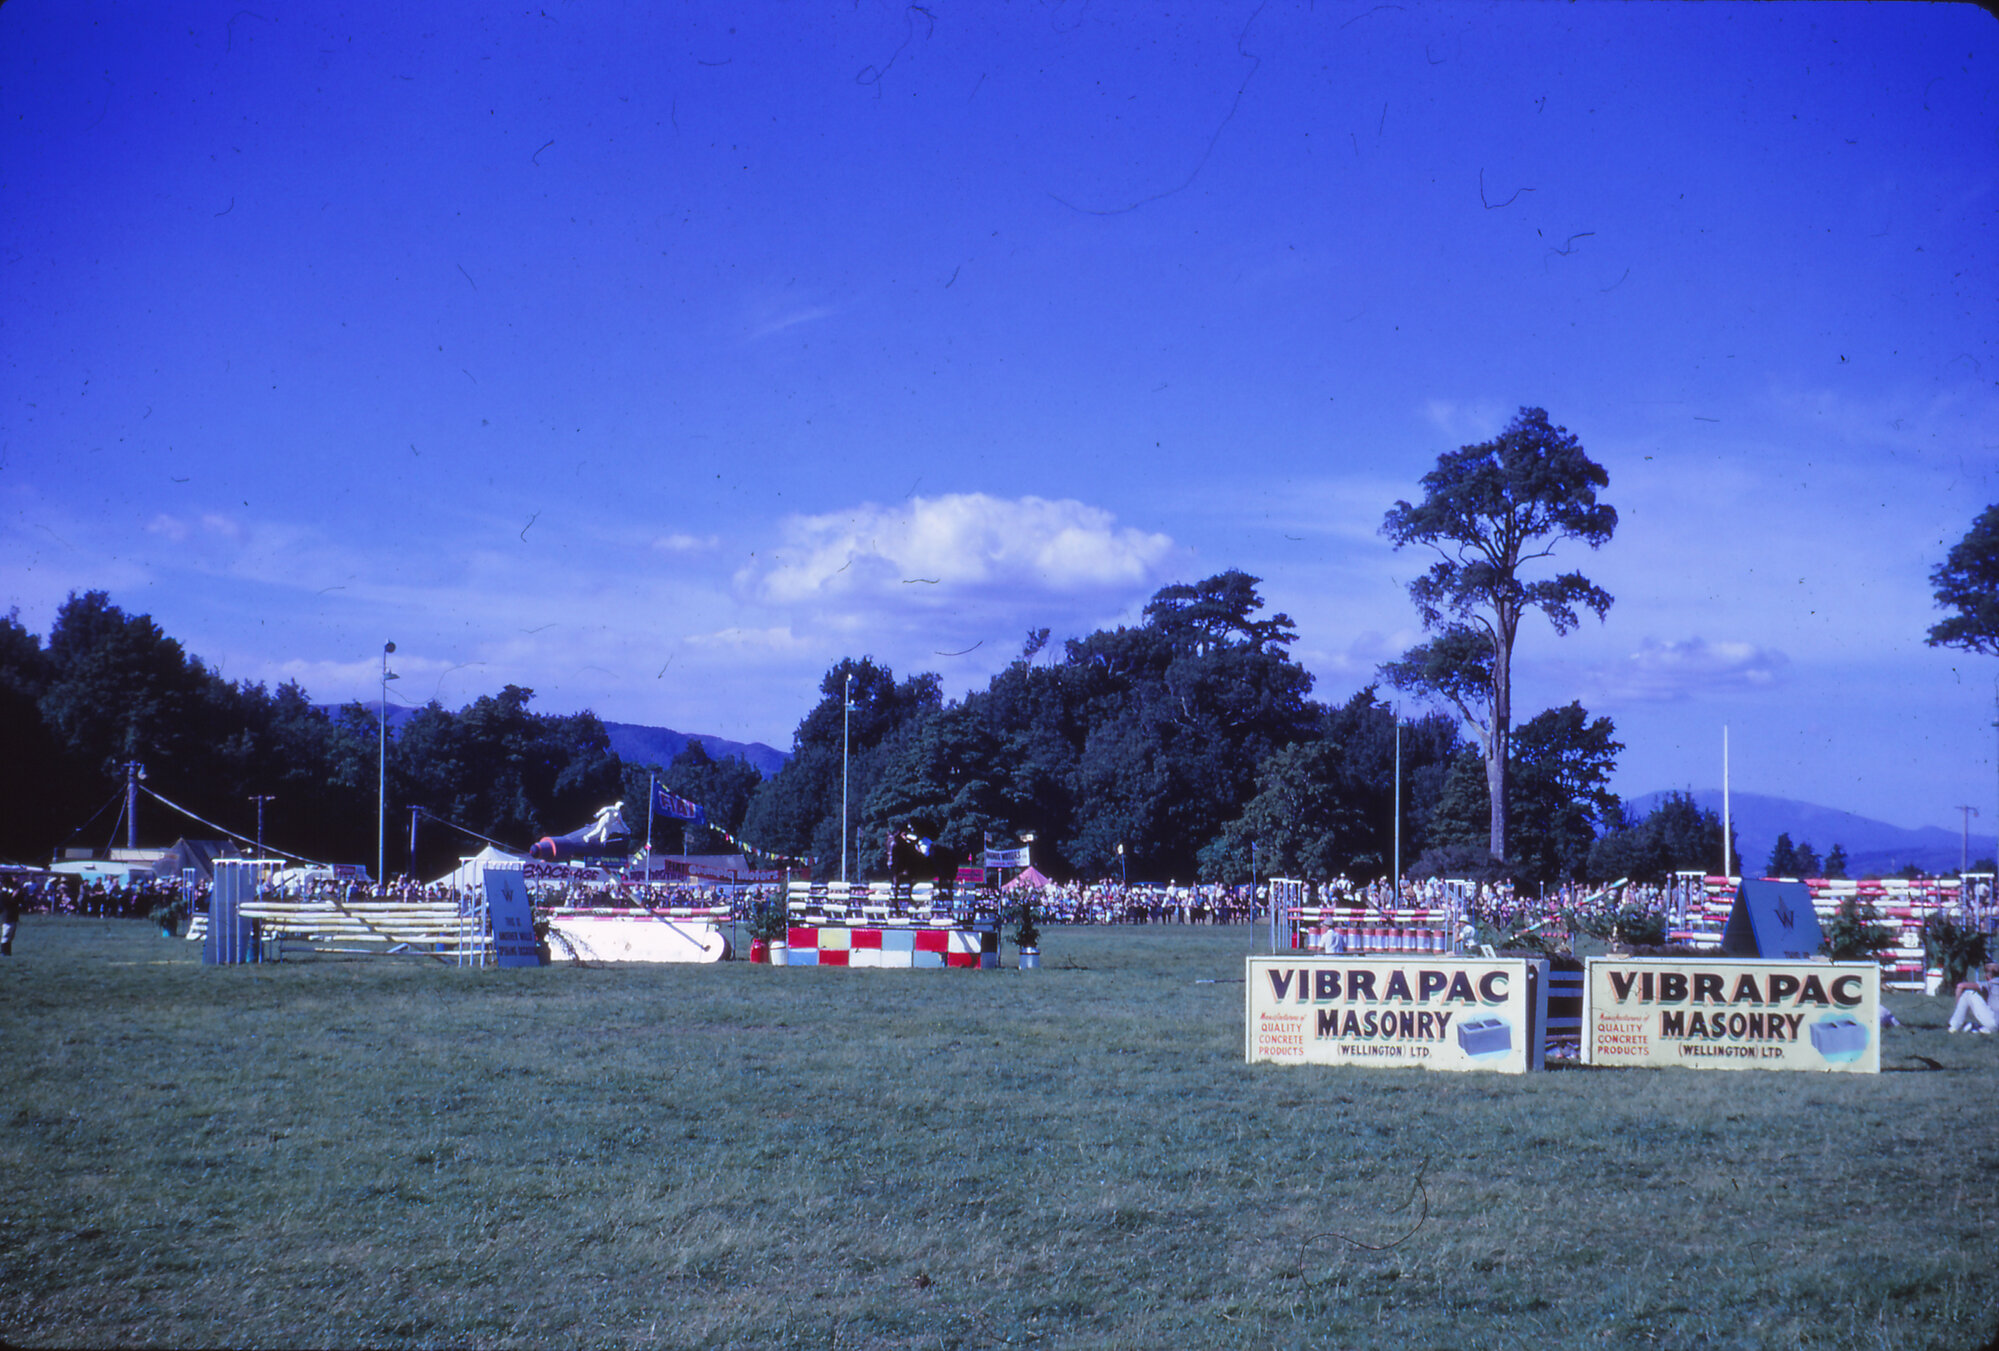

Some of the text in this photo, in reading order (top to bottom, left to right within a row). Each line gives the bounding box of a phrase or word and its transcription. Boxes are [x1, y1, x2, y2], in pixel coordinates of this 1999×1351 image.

[658, 791, 696, 818] FIAT
[574, 868, 600, 880] AGE
[688, 864, 732, 879] Olympic
[737, 869, 779, 881] Motors
[1267, 969, 1509, 1005] VIBRAPAC
[1608, 971, 1862, 1007] VIBRAPAC
[1261, 1023, 1302, 1033] QUALITY
[1316, 1009, 1453, 1041] MASONRY
[1598, 1023, 1642, 1033] QUALITY
[1660, 1010, 1804, 1041] MASONRY
[1259, 1034, 1304, 1045] CONCRETE
[1598, 1034, 1648, 1044] CONCRETE
[1258, 1046, 1305, 1056] PRODUCTS
[1337, 1043, 1433, 1058] (WELLINGTON) LTD.
[1598, 1045, 1649, 1056] PRODUCTS
[1678, 1043, 1785, 1058] (WELLINGTON) LTD.
